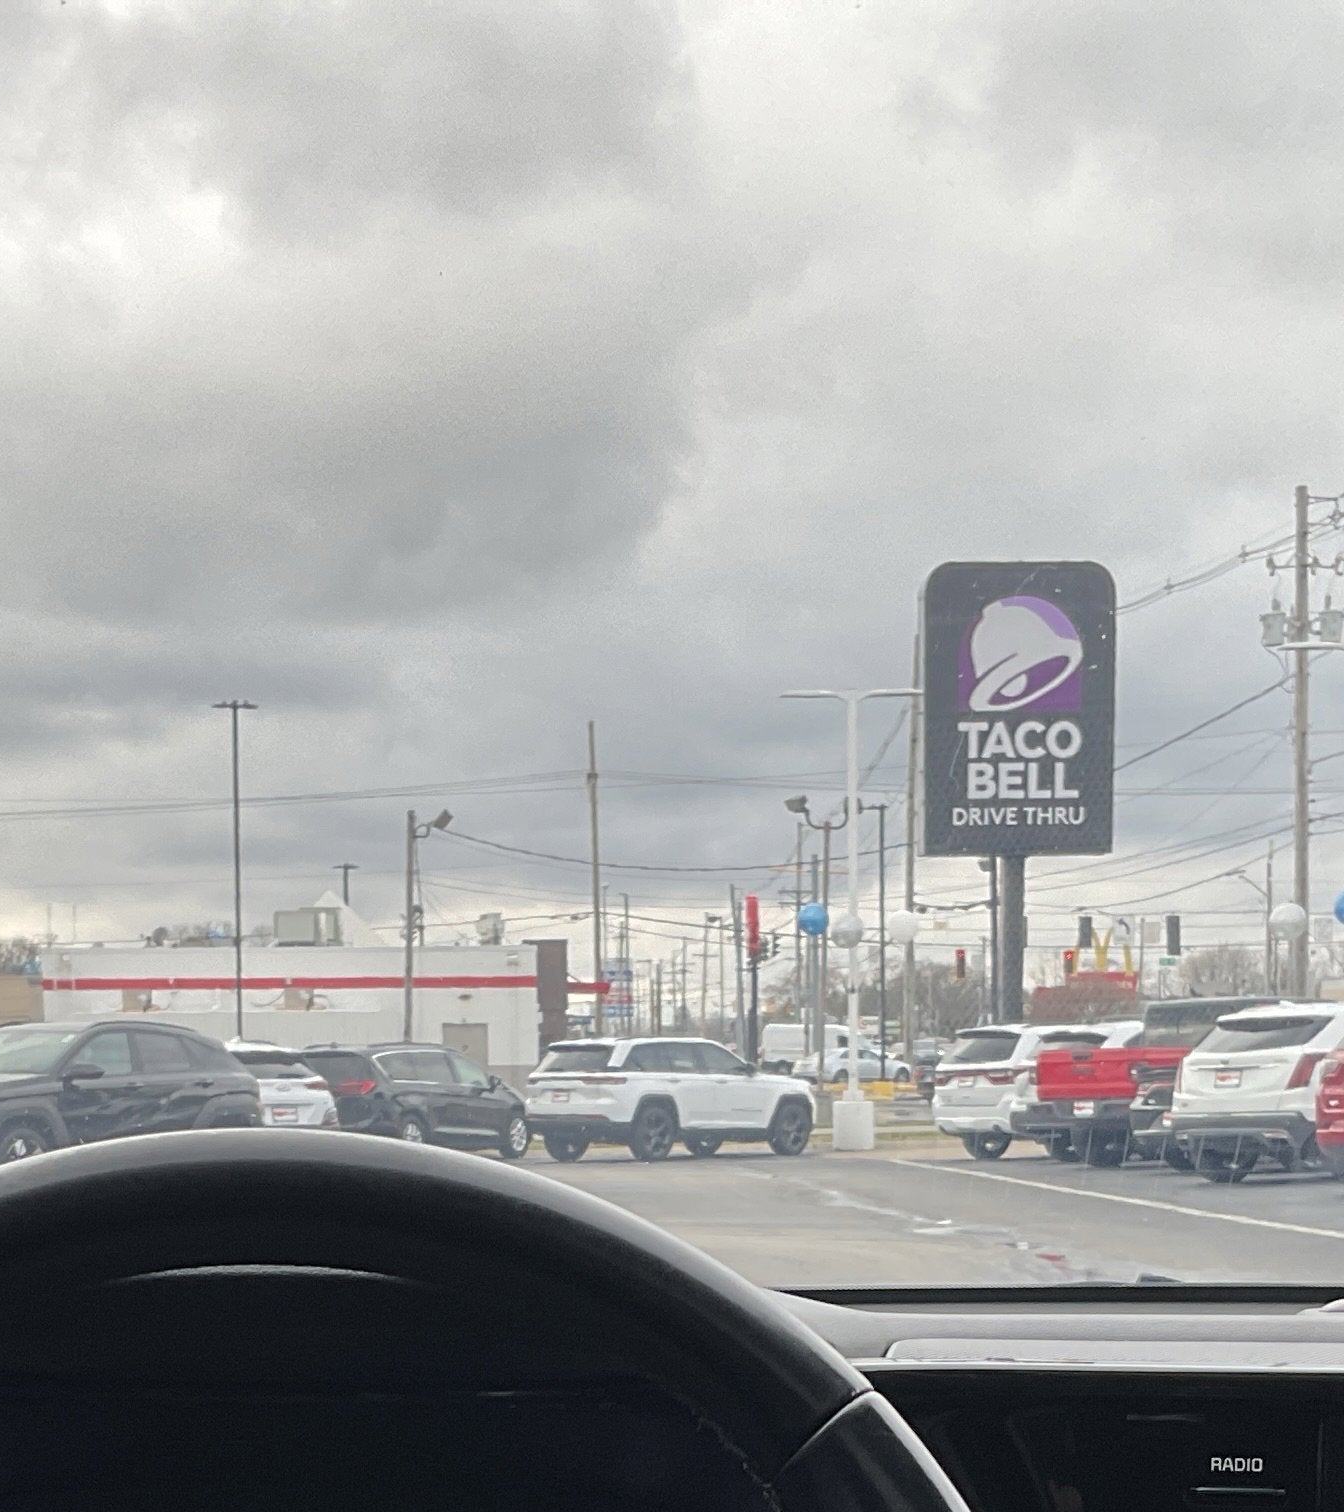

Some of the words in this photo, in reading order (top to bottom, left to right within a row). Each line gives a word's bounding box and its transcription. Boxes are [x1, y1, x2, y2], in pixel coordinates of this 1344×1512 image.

[957, 721, 1082, 758] TACO
[967, 762, 1079, 799] BELL
[952, 807, 1018, 826] DRIVE
[1023, 806, 1085, 825] THRU
[1210, 1457, 1263, 1472] RADIO
